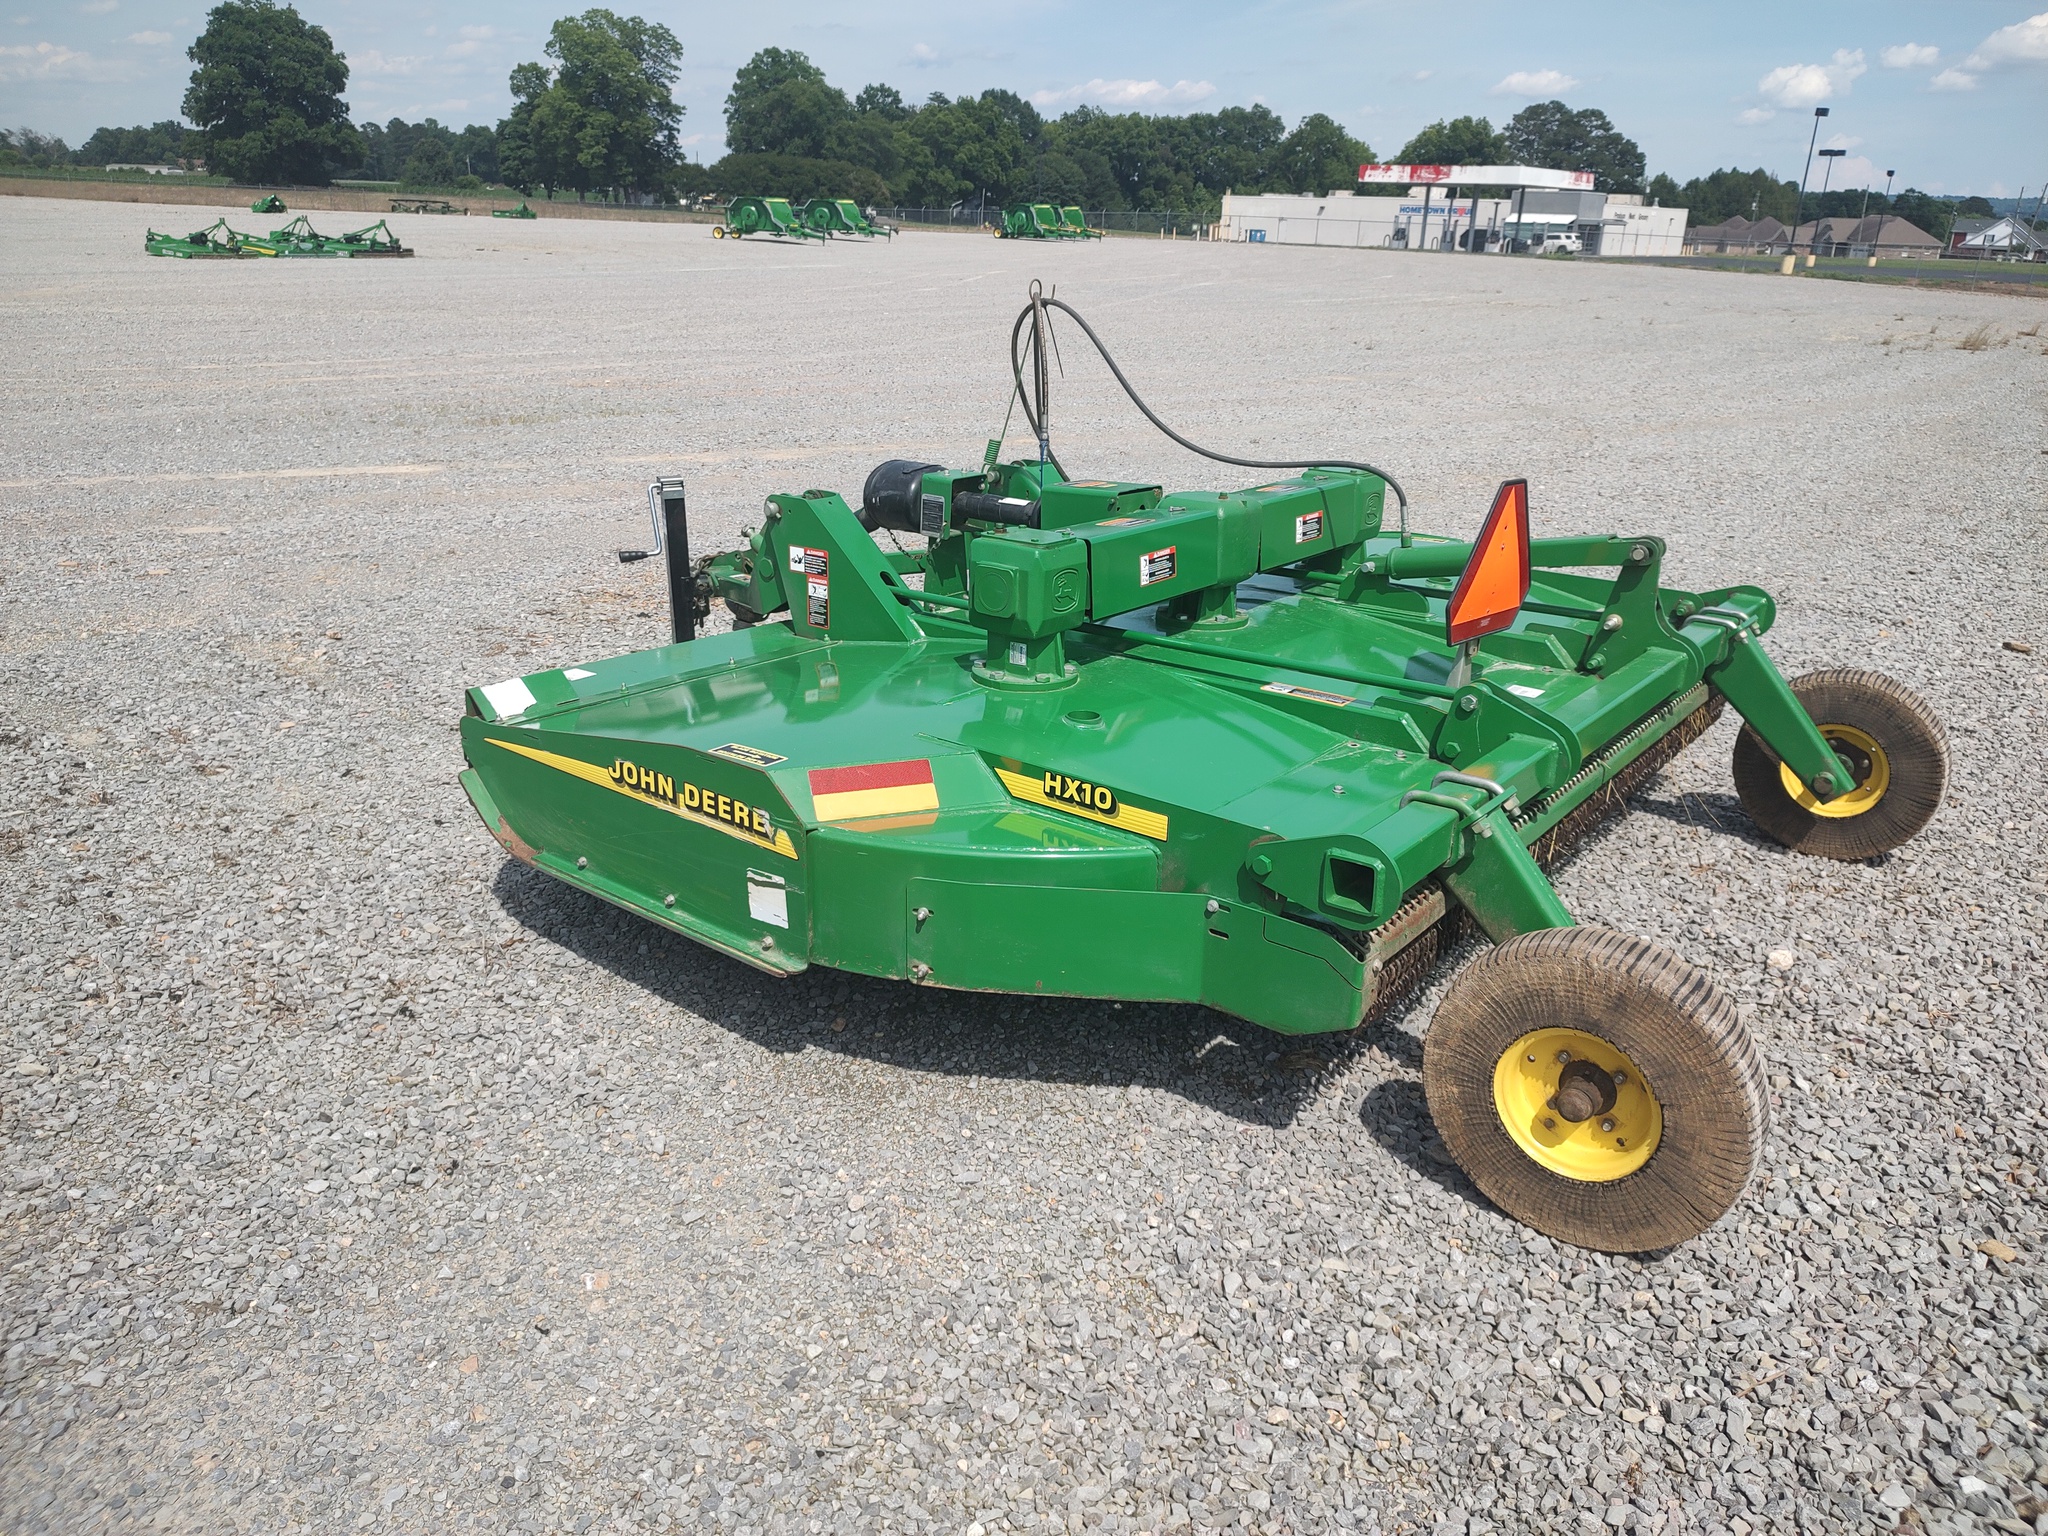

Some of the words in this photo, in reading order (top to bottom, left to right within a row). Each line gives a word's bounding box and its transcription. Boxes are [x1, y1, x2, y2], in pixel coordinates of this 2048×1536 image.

[1400, 206, 1445, 215] HOMEOWN
[607, 759, 676, 803] JOHN
[683, 781, 773, 839] DEERE
[1044, 771, 1115, 813] HX10
